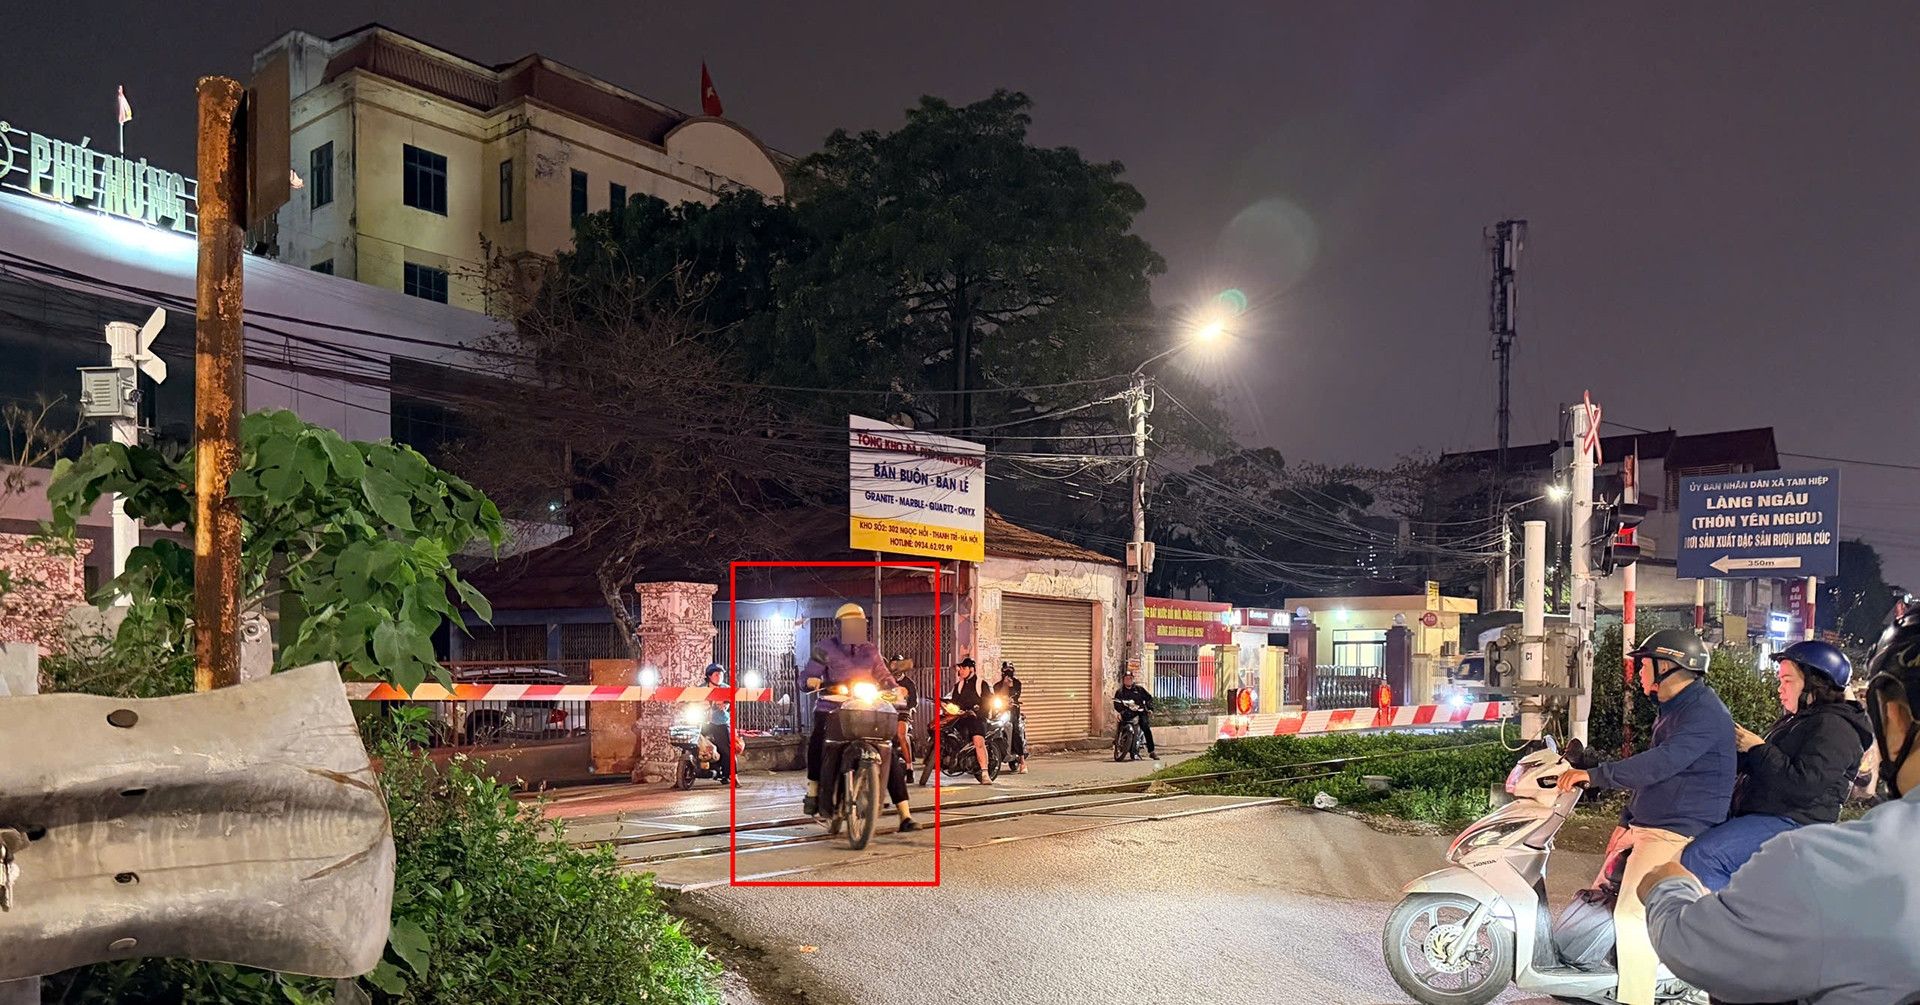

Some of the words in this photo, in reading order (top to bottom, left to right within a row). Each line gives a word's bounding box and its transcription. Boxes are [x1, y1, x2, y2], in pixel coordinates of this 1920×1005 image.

[31, 131, 94, 203] PHÚ
[104, 155, 186, 231] HƯNG
[884, 440, 903, 451] KHO
[874, 461, 896, 480] BÁN
[900, 468, 928, 486] BUÔN
[936, 474, 956, 490] BÁN
[960, 476, 969, 493] LẺ
[1690, 482, 1701, 492] ỦY
[1723, 481, 1747, 490] NHÂN
[1750, 479, 1769, 488] DÂN
[1772, 478, 1784, 486] XÃ
[1786, 478, 1806, 486] TAM
[1808, 476, 1829, 486] HIỆP
[865, 491, 894, 504] GRANITE
[900, 497, 924, 509] MARBLE
[929, 502, 954, 514] QUARTZ
[958, 506, 976, 517] ONYX
[1706, 494, 1753, 510] LÀNG
[1758, 492, 1809, 507] NGÂU
[1692, 516, 1736, 530] (THÔN
[1740, 512, 1769, 527] YÊN
[1773, 511, 1823, 526] NGƯU)
[860, 521, 872, 529] KHO
[900, 528, 917, 537] NGỌC
[932, 531, 949, 539] THANH
[961, 534, 968, 542] HÀ
[1699, 532, 1715, 548] SẢN
[1716, 532, 1736, 547] XUẤT
[1738, 533, 1753, 549] ĐẶC
[1755, 530, 1772, 546] SẢN
[1773, 532, 1794, 548] RƯỢU
[1796, 532, 1812, 545] HOA
[1814, 530, 1830, 544] CÚC
[890, 538, 914, 547] HOTLINE:
[915, 541, 953, 552] 0934.62.92.99
[1526, 652, 1532, 660] C1
